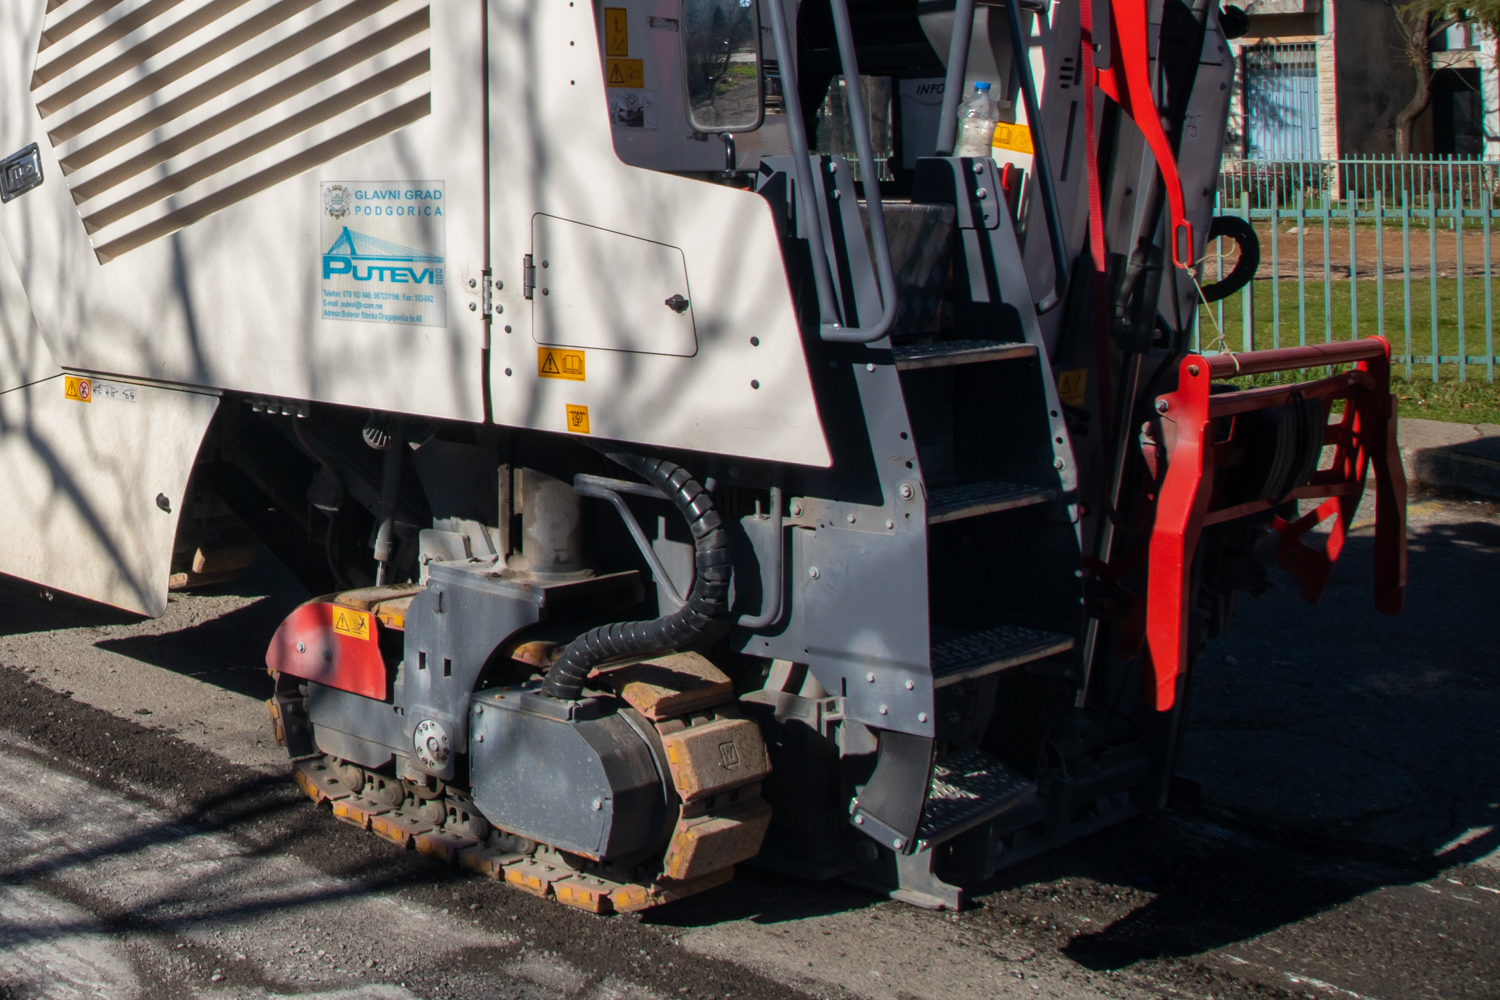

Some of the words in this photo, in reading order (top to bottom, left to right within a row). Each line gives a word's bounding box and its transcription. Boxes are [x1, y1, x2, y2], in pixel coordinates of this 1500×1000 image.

[916, 83, 945, 95] INFO
[354, 190, 401, 200] GLAVNI
[404, 189, 443, 200] GRAD
[354, 205, 443, 216] PODGORICA
[322, 255, 435, 284] PUTEVI
[323, 289, 342, 298] Telefon:
[402, 293, 414, 302] Fax:
[323, 299, 339, 307] E-mail:
[361, 311, 378, 320] Stanka
